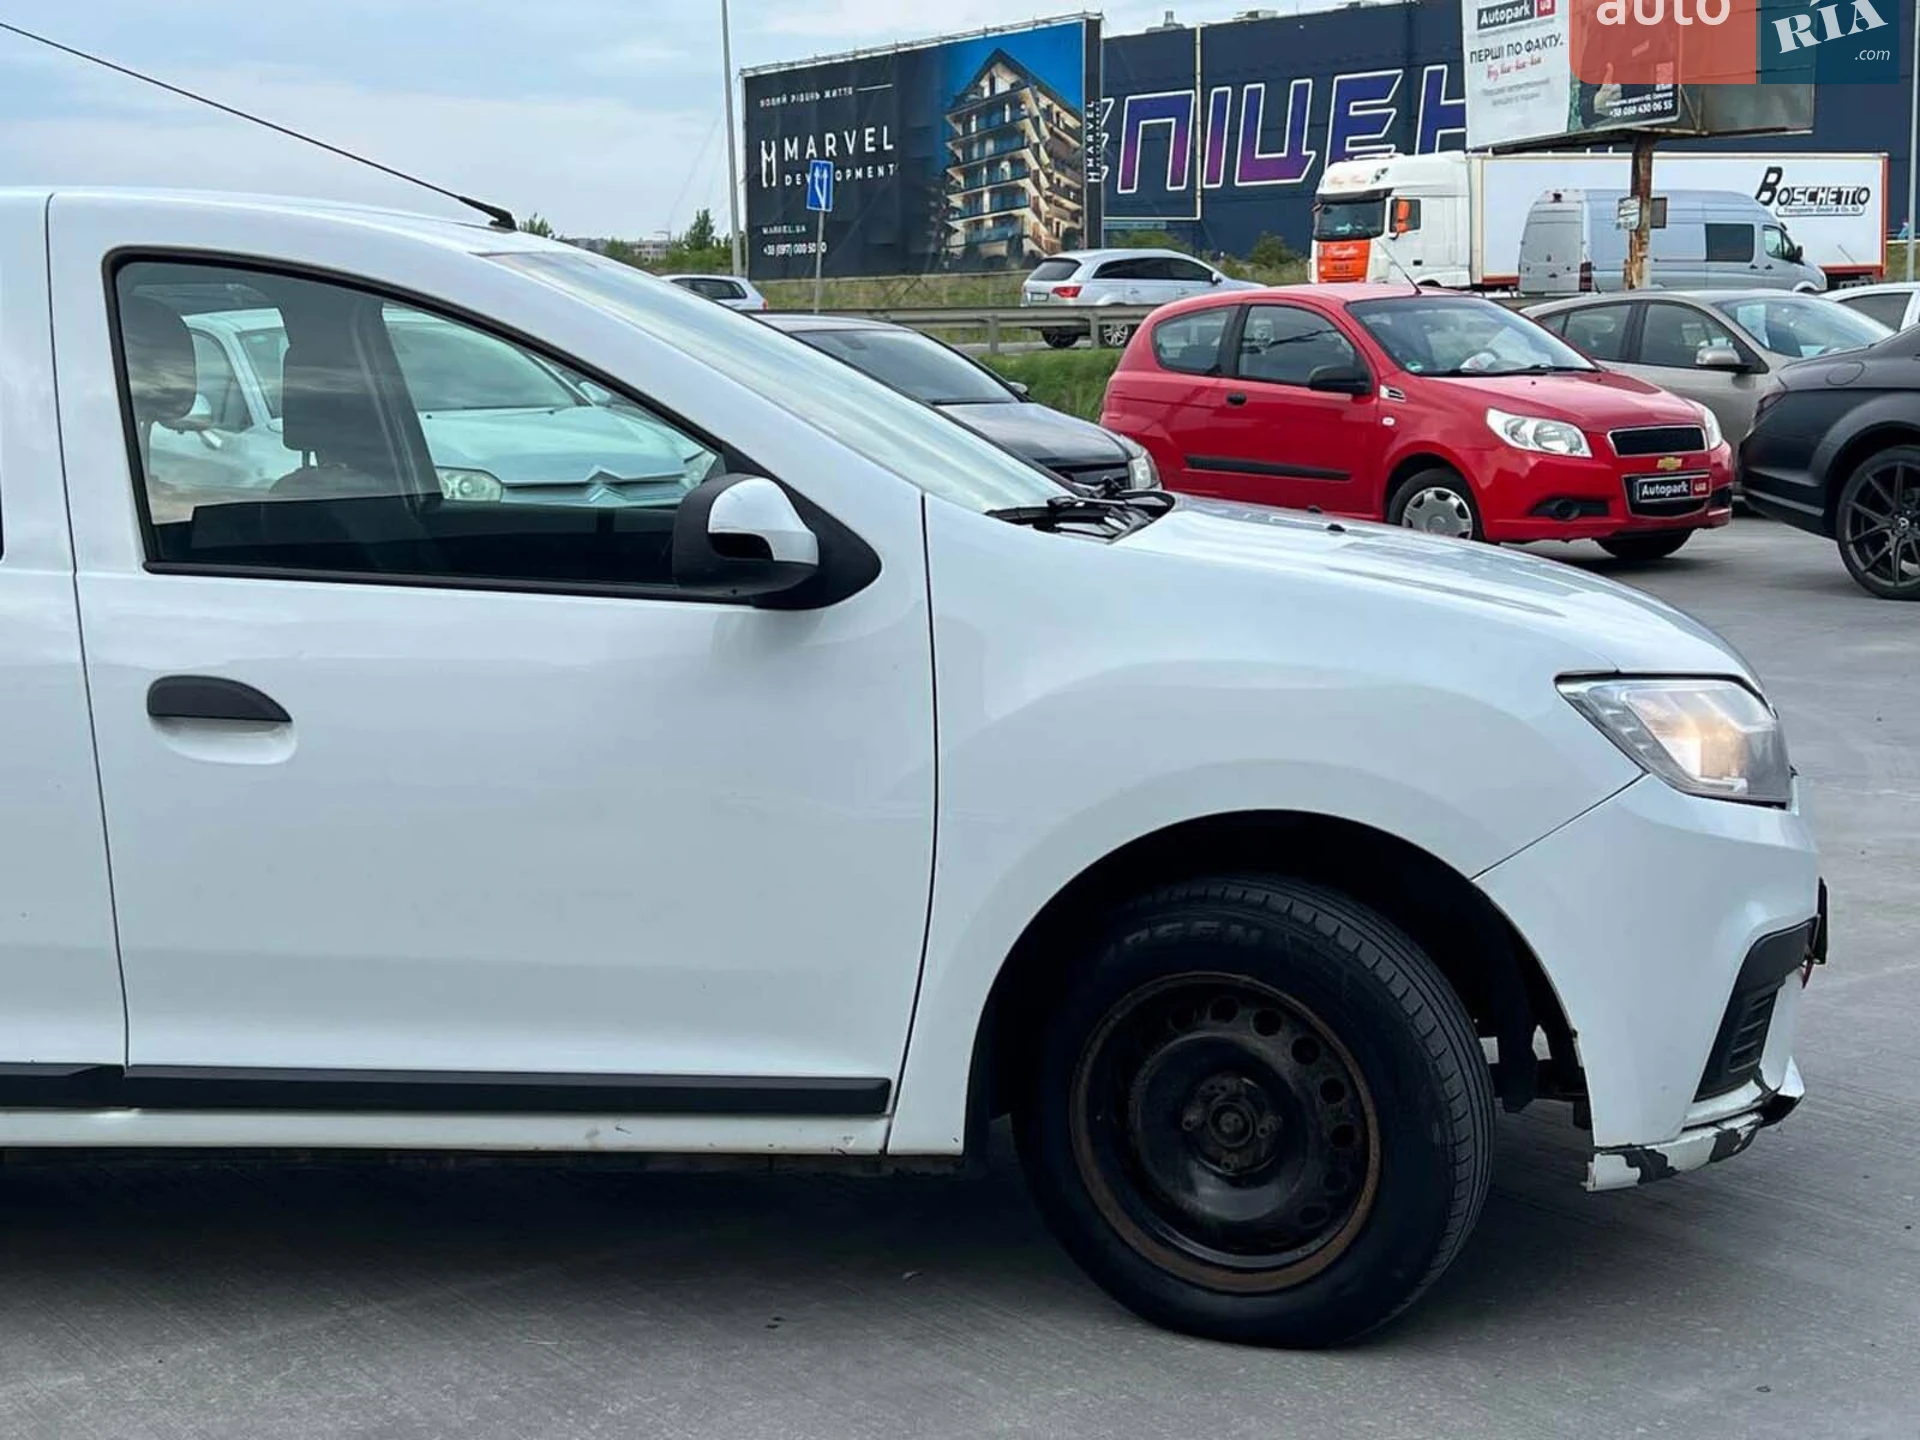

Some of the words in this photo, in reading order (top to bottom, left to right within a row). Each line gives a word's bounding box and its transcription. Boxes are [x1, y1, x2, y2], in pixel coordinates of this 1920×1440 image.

[1480, 0, 1531, 25] Autopark
[1470, 45, 1504, 64] ПЕРШІ
[1506, 42, 1523, 57] ПО
[784, 125, 893, 161] MARVEL
[785, 163, 895, 186] DEVOPMENT
[1642, 481, 1689, 496] Autopark
